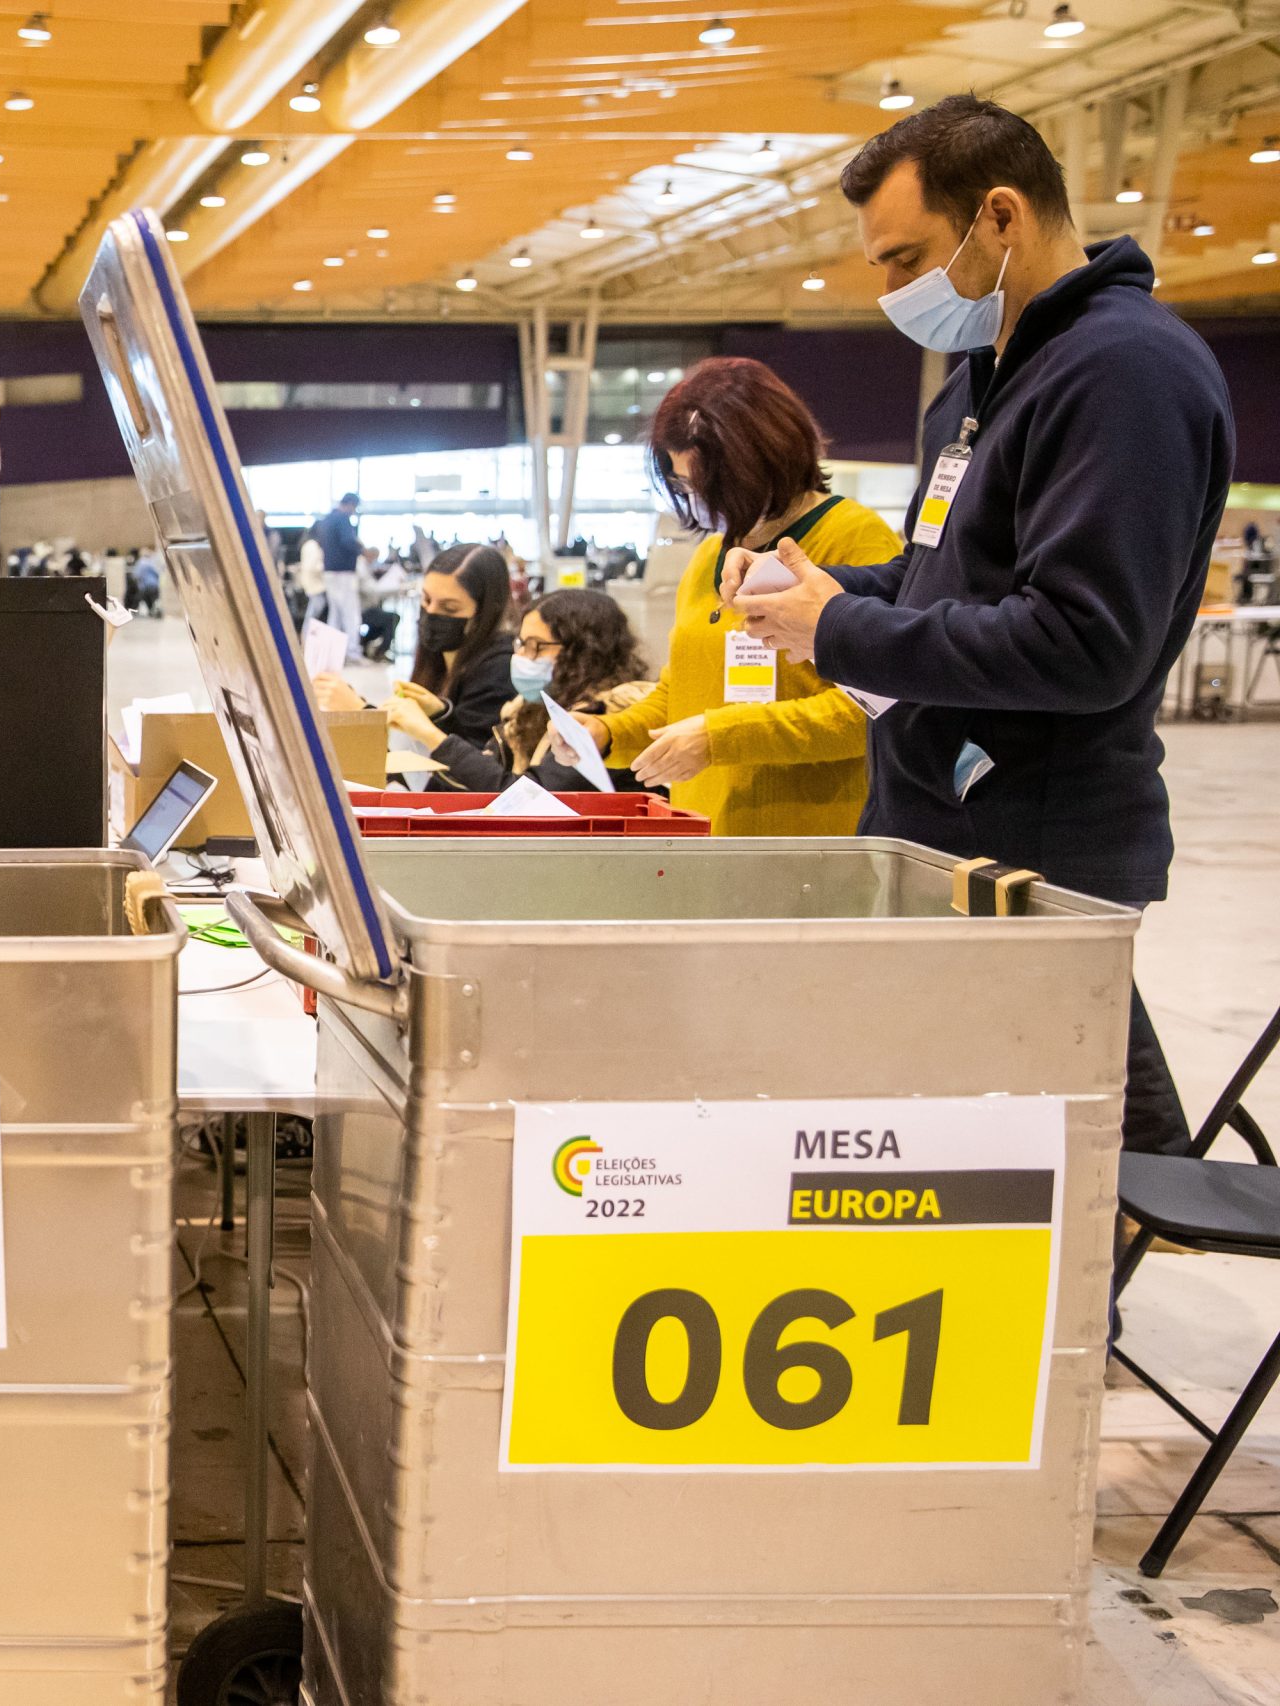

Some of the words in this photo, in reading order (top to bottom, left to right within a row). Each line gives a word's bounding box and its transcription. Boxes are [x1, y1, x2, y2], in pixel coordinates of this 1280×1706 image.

[937, 473, 957, 482] MEMBRO
[940, 485, 952, 493] MESA
[793, 1129, 902, 1160] MESA
[595, 1156, 657, 1172] ELEIÇÕES
[595, 1173, 683, 1186] LEGISLATIVAS
[585, 1198, 646, 1218] 2022
[791, 1188, 942, 1219] EUROPA
[611, 1287, 945, 1431] 061
